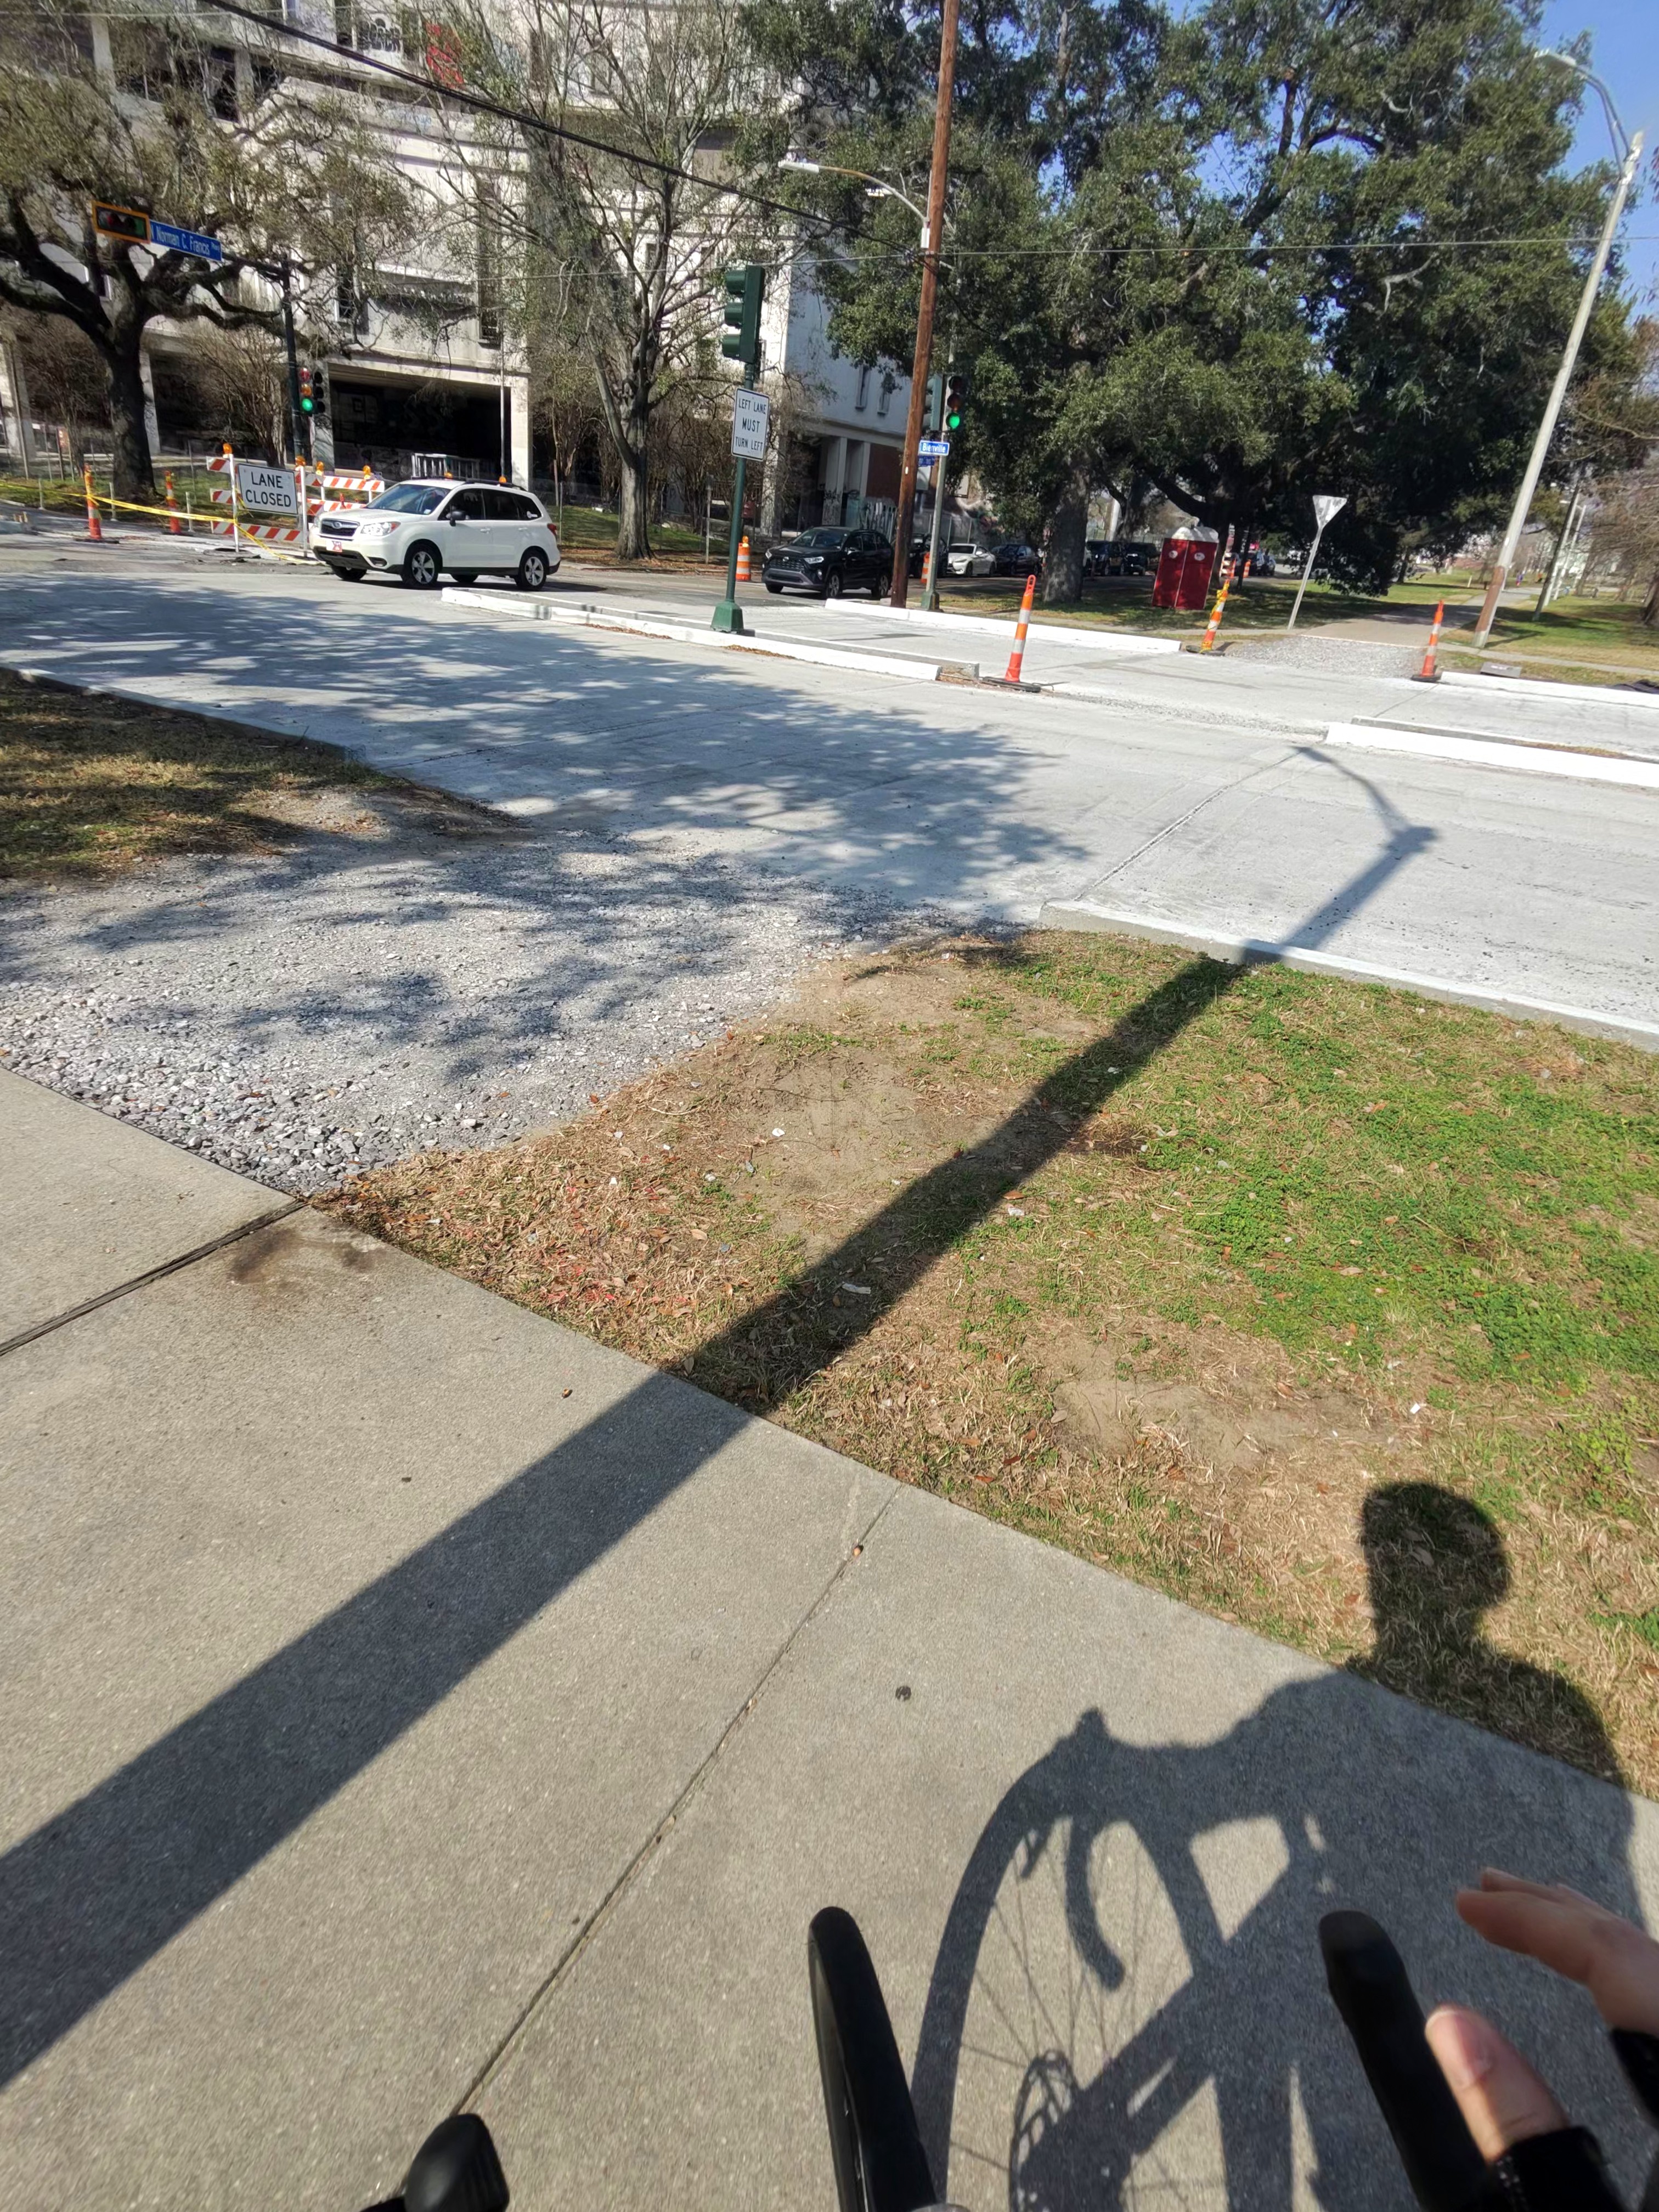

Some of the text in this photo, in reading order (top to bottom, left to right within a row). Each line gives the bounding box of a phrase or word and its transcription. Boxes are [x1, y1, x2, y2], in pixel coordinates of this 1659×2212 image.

[189, 235, 210, 256] Francis
[738, 398, 766, 414] LEFT LANE
[742, 417, 760, 433] MUST
[735, 436, 763, 452] TURN LEFT
[922, 443, 946, 453] Bienville
[251, 471, 284, 489] LANE
[245, 489, 291, 507] CLOSED
